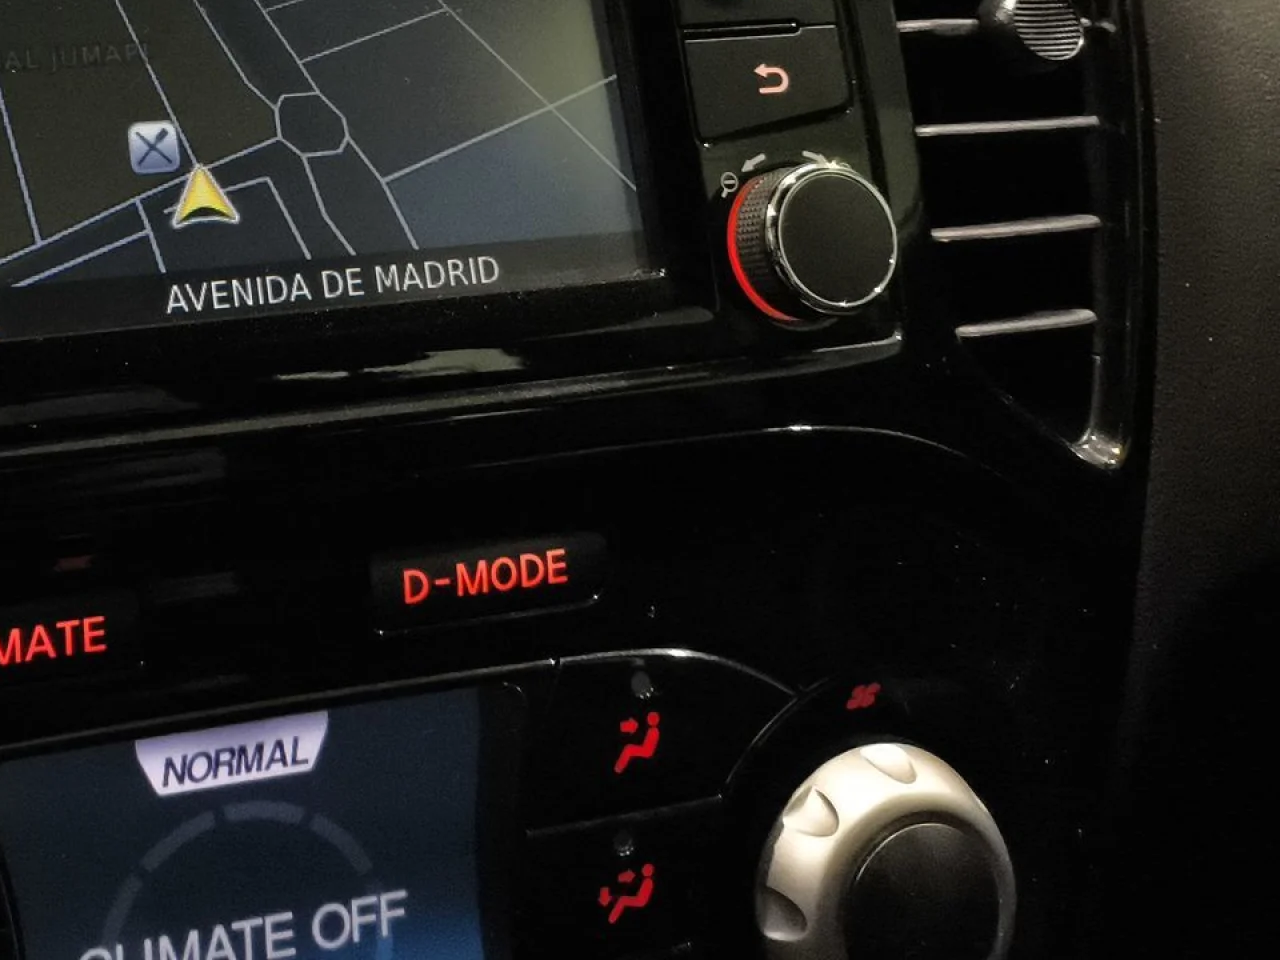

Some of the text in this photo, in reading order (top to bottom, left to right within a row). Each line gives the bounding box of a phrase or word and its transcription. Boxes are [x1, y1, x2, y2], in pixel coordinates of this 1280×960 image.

[167, 255, 500, 314] AVENIDA DE MADRID
[403, 548, 568, 604] D-MODE
[162, 736, 309, 788] NORMAL
[79, 890, 408, 960] IMATE OFF
